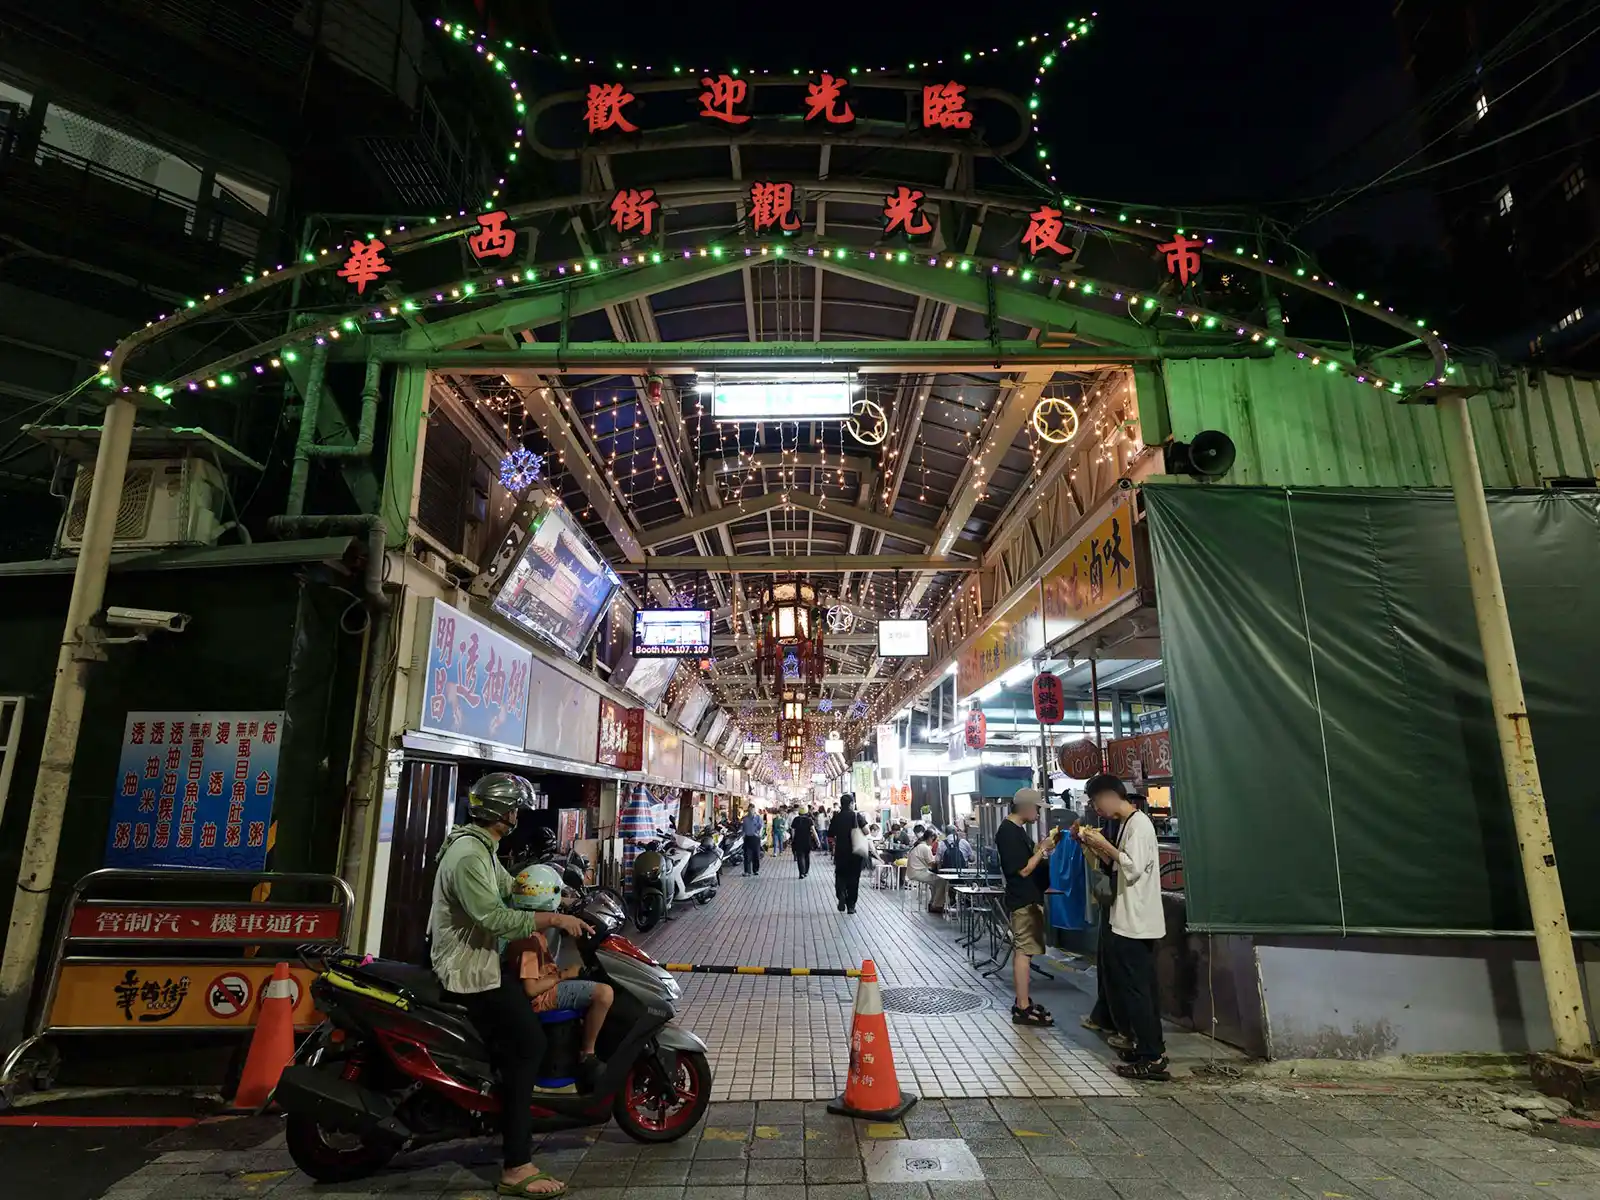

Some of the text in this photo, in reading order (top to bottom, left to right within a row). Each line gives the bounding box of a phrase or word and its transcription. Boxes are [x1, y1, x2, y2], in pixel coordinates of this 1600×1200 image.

[583, 74, 973, 134] 歡迎光臨
[337, 181, 1205, 294] 華西街觀光夜市
[635, 645, 660, 654] Booth
[694, 645, 709, 654] 109
[96, 911, 320, 934] 管制汽、機車通行
[861, 1031, 875, 1087] 華西街
